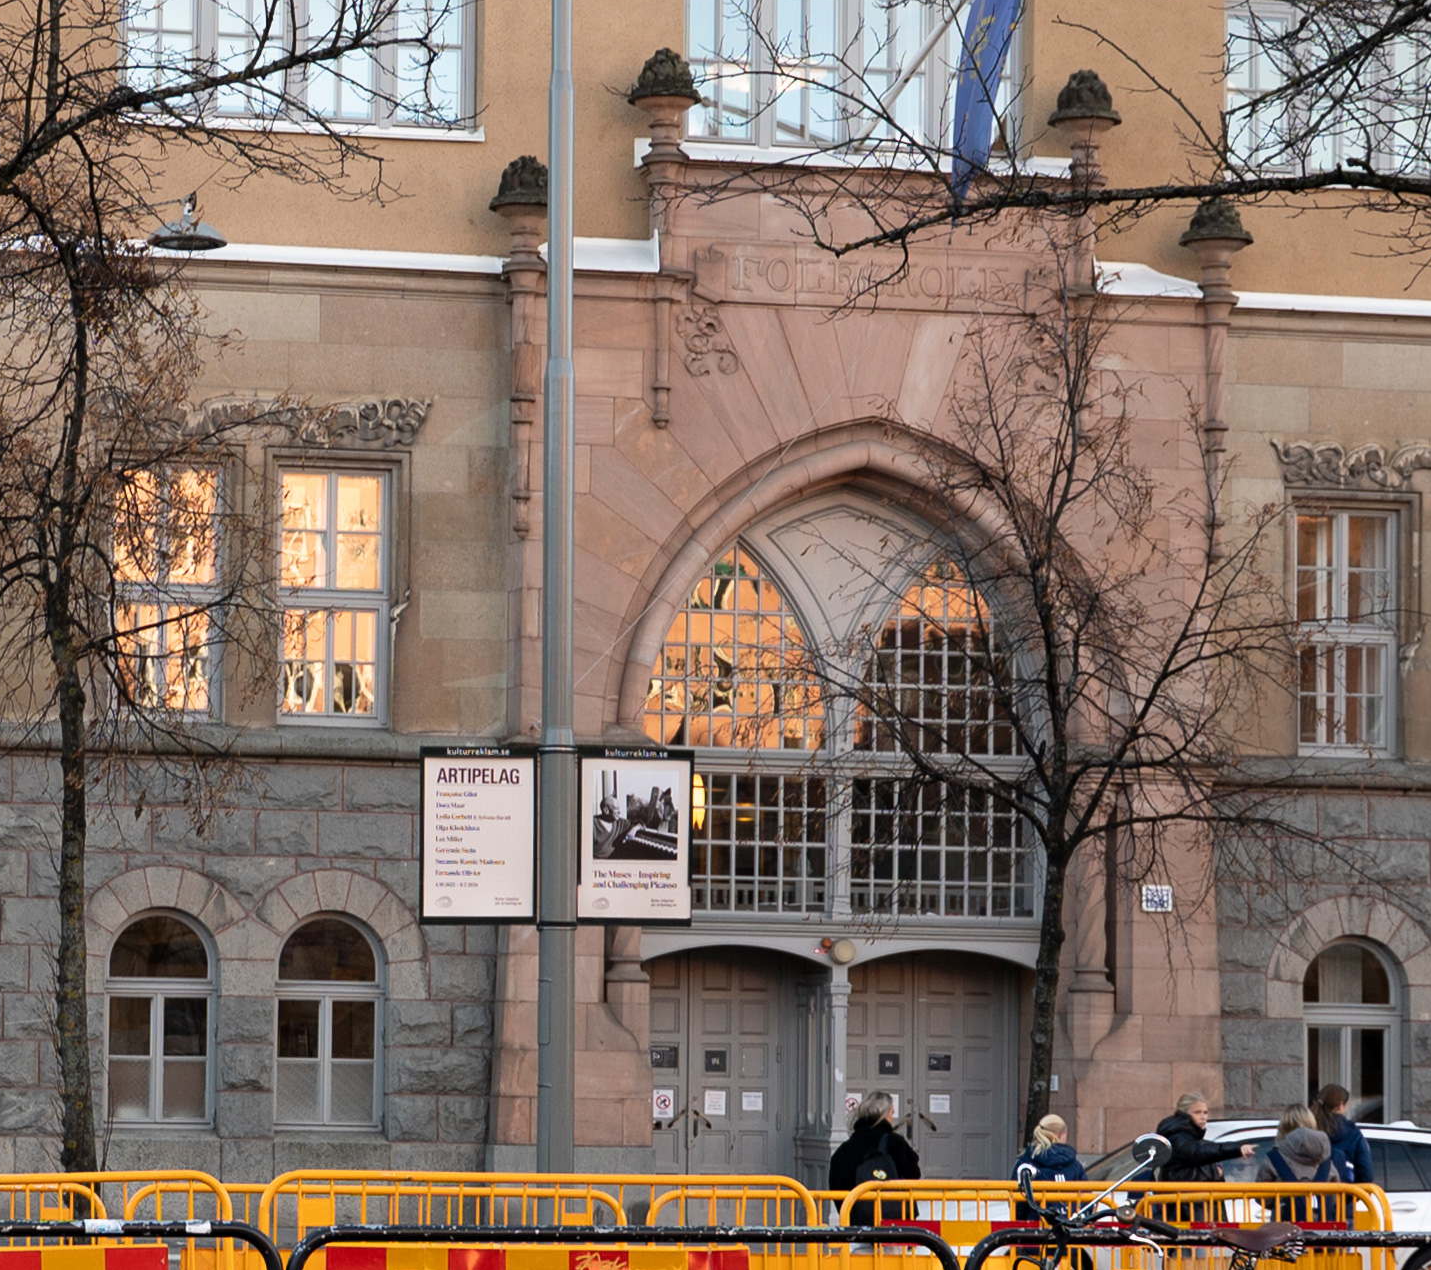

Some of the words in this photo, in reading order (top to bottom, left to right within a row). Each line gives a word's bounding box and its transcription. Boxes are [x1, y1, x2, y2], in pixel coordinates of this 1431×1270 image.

[446, 747, 511, 756] kulturreklam.se
[605, 748, 668, 758] kulturreklam.se
[437, 768, 520, 784] ARTIPELAG
[593, 870, 607, 878] The
[608, 870, 632, 878] Muses
[638, 870, 671, 880] Inspiring
[607, 881, 649, 890] Challenging
